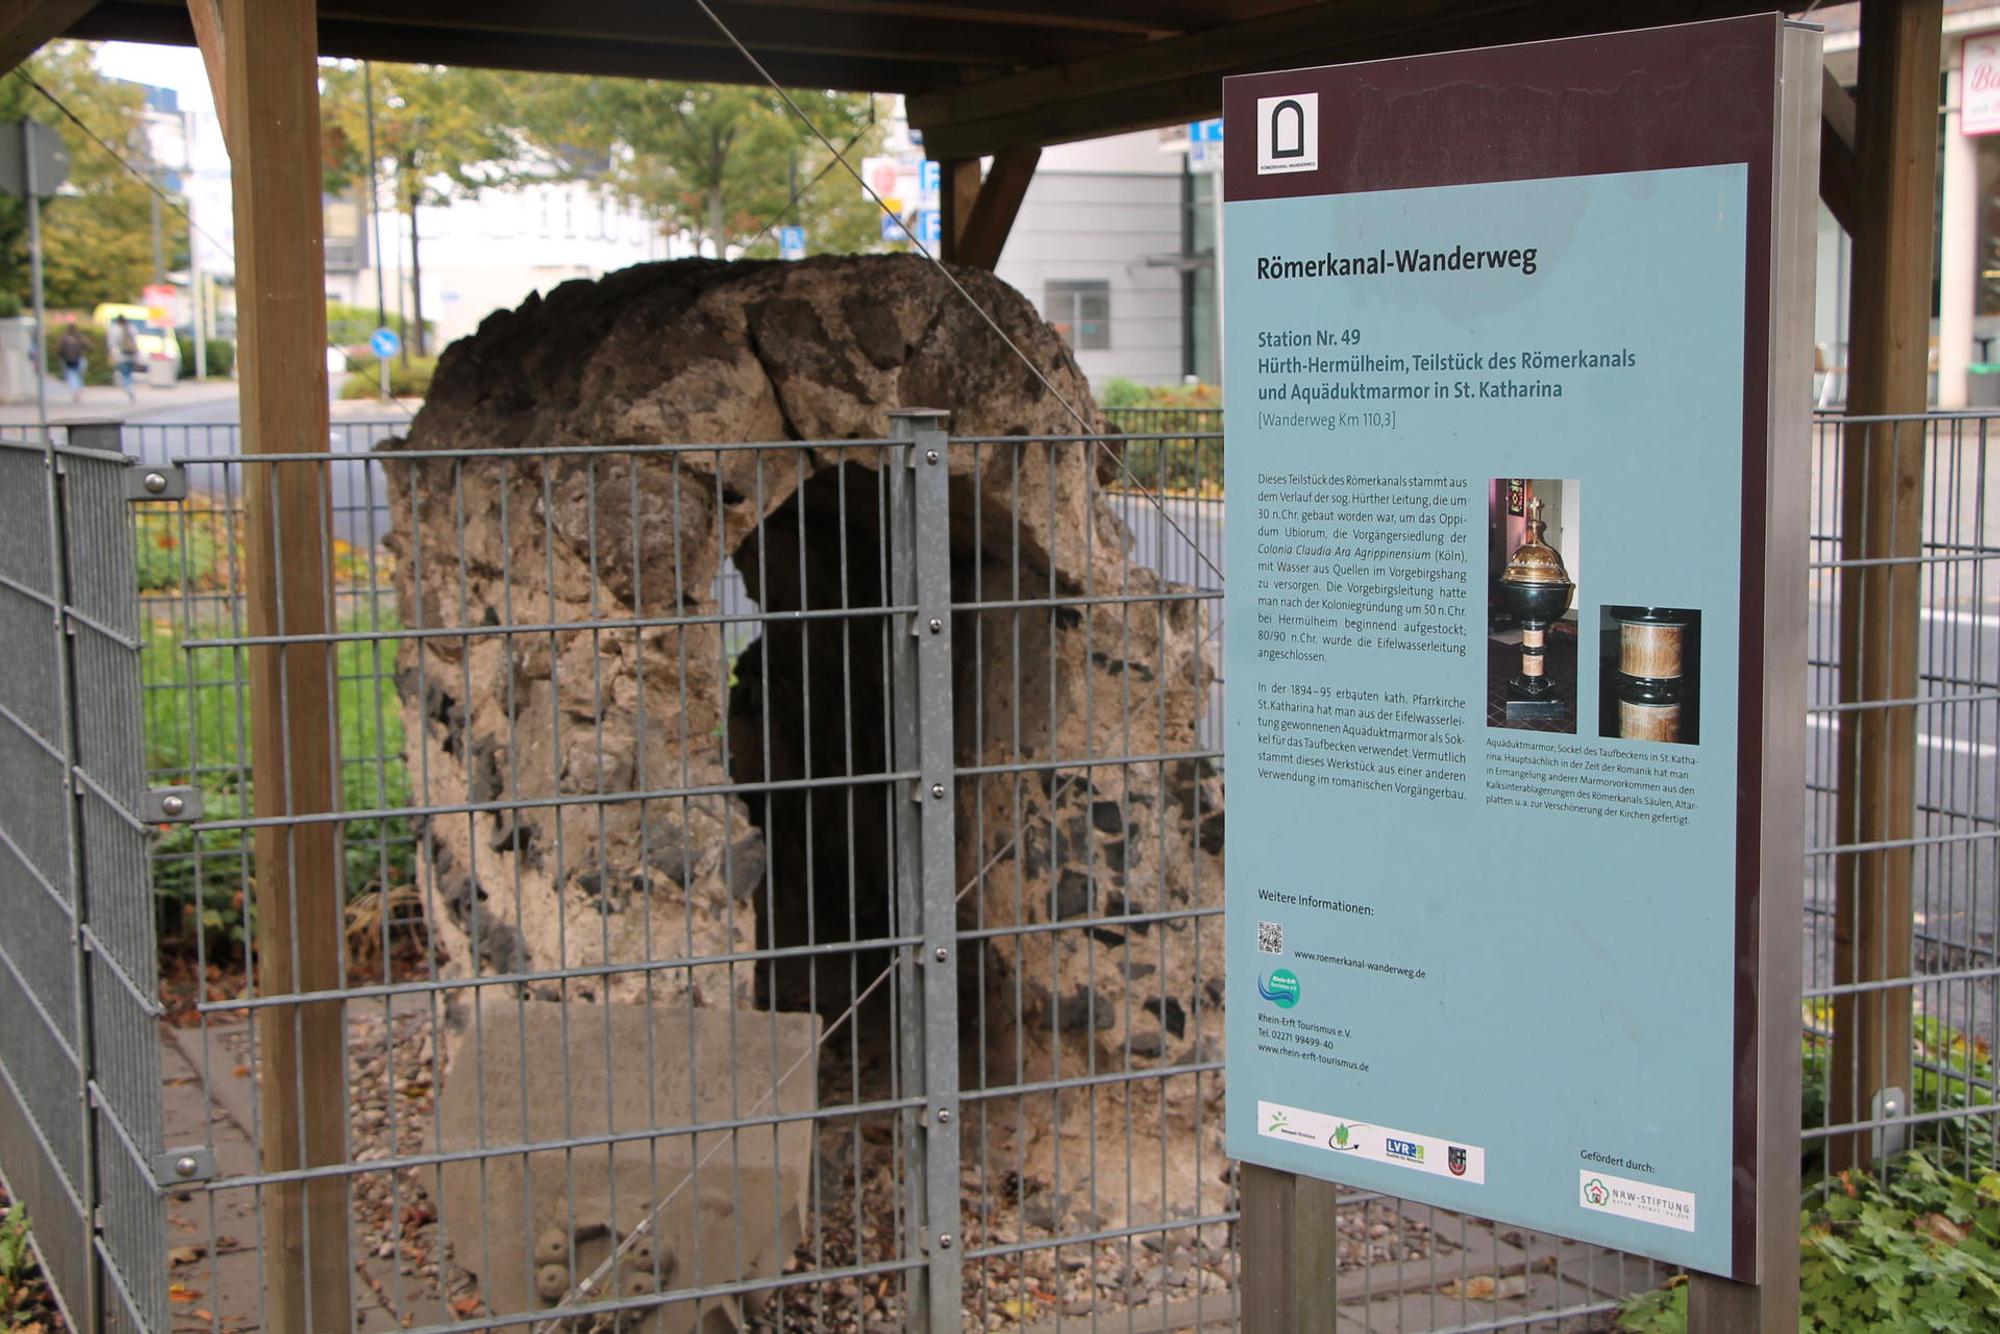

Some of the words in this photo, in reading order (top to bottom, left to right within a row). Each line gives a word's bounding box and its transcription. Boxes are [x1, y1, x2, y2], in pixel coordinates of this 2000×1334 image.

[1257, 245, 1537, 279] Römerkanal-Wanderweg
[1258, 330, 1311, 346] Station
[1317, 330, 1337, 345] Nr.
[1341, 329, 1360, 345] 49
[1258, 355, 1409, 374] Hürth-Hermülheim,
[1413, 352, 1483, 371] Teilstück
[1488, 352, 1516, 370] des
[1521, 348, 1636, 369] Römerkanals
[1258, 383, 1286, 400] und
[1291, 382, 1430, 405] Aquäduktmarmor
[1435, 381, 1449, 398] in
[1454, 382, 1475, 398] St.
[1480, 380, 1562, 398] Katharina
[1258, 412, 1335, 432] [Wanderweg
[1339, 413, 1359, 427] Km
[1363, 411, 1396, 432] 110,3]
[1258, 474, 1287, 484] Dieses
[1289, 474, 1327, 486] Teilstück
[1329, 474, 1344, 485] des
[1347, 475, 1407, 486] Römerkanals
[1409, 477, 1448, 488] stammt
[1449, 479, 1467, 487] aus
[1258, 491, 1277, 501] dem
[1280, 491, 1312, 502] Verlauf
[1314, 492, 1328, 503] der
[1352, 493, 1389, 504] Hürther
[1393, 494, 1431, 508] Leitung,
[1433, 494, 1447, 505] die
[1451, 497, 1466, 507] um
[1258, 509, 1269, 519] 30
[1302, 510, 1334, 523] gebaut
[1338, 511, 1373, 522] worden
[1377, 514, 1396, 524] war,
[1400, 515, 1415, 523] um
[1419, 512, 1436, 524] das
[1440, 513, 1467, 528] Oppi-
[1258, 526, 1278, 536] dum
[1285, 526, 1328, 539] Ubiorum,
[1333, 528, 1347, 539] die
[1353, 528, 1444, 546] Vorgängersiedlung
[1450, 532, 1466, 543] der
[1258, 543, 1292, 555] Colonia
[1296, 544, 1331, 556] Claudia
[1335, 547, 1350, 557] Ara
[1354, 547, 1431, 561] Agrippinensium
[1258, 561, 1274, 571] mit
[1277, 561, 1309, 573] Wasser
[1313, 565, 1329, 574] aus
[1333, 563, 1369, 577] Quellen
[1373, 566, 1385, 576] im
[1389, 566, 1467, 583] Vorgebirgshang
[1258, 580, 1268, 588] zu
[1274, 581, 1321, 593] versorgen.
[1327, 581, 1342, 592] Die
[1347, 582, 1433, 600] Vorgebirgsleitung
[1440, 586, 1466, 599] hatte
[1258, 597, 1277, 608] man
[1281, 596, 1302, 607] nach
[1305, 598, 1319, 608] der
[1322, 599, 1403, 617] Koloniegründung
[1406, 604, 1421, 614] um
[1424, 604, 1436, 616] 50
[1258, 612, 1271, 623] bei
[1278, 614, 1337, 627] Hermülheim
[1345, 617, 1397, 632] beginnend
[1258, 630, 1286, 641] 80/90
[1323, 635, 1352, 646] wurde
[1358, 636, 1372, 647] die
[1378, 637, 1466, 656] Eifelwasserleitung
[1258, 649, 1327, 664] angeschlossen.
[1258, 682, 1266, 692] In
[1272, 682, 1286, 694] der
[1336, 688, 1378, 702] erbauten
[1384, 691, 1407, 705] kath.
[1413, 694, 1465, 709] Pfarrkirche
[1271, 701, 1314, 714] Katharina
[1317, 703, 1331, 715] hat
[1335, 707, 1355, 717] man
[1358, 710, 1374, 719] aus
[1377, 709, 1392, 720] der
[1396, 711, 1465, 726] Eifelwasserlei-
[1258, 716, 1280, 731] tung
[1281, 720, 1340, 735] gewonnenen
[1343, 724, 1427, 744] Aquäduktmarmor
[1429, 732, 1442, 743] als
[1445, 733, 1465, 744] Sok-
[1258, 733, 1270, 744] kel
[1273, 734, 1285, 745] für
[1287, 736, 1302, 747] das
[1305, 738, 1355, 752] Taufbecken
[1358, 743, 1410, 758] verwendet.
[1412, 748, 1465, 764] Vermutlich
[1258, 750, 1293, 764] stammt
[1297, 754, 1324, 768] dieses
[1327, 758, 1375, 772] Werkstück
[1378, 765, 1394, 774] aus
[1398, 765, 1422, 777] einer
[1425, 768, 1465, 781] anderen
[1258, 768, 1315, 787] Verwendung
[1318, 774, 1329, 784] im
[1332, 777, 1392, 792] romanischen
[1258, 888, 1296, 904] Weitere
[1299, 895, 1374, 917] Informationen:
[1295, 951, 1426, 979] www.roemerkanal-wanderweg.de
[1258, 1013, 1296, 1028] Rhein-Erft
[1298, 1019, 1336, 1035] Tourismus
[1338, 1027, 1352, 1039] e.V.
[1259, 1028, 1270, 1038] Tel.
[1272, 1030, 1292, 1042] 02271
[1295, 1034, 1333, 1050] 99499-40
[1258, 1044, 1369, 1072] www.rhein-erft-tourismus.de
[1387, 1140, 1410, 1154] LVR
[1581, 1149, 1623, 1167] Gefördert
[1626, 1159, 1655, 1174] durch:
[1612, 1189, 1690, 1213] NRW-STIFTUNG
